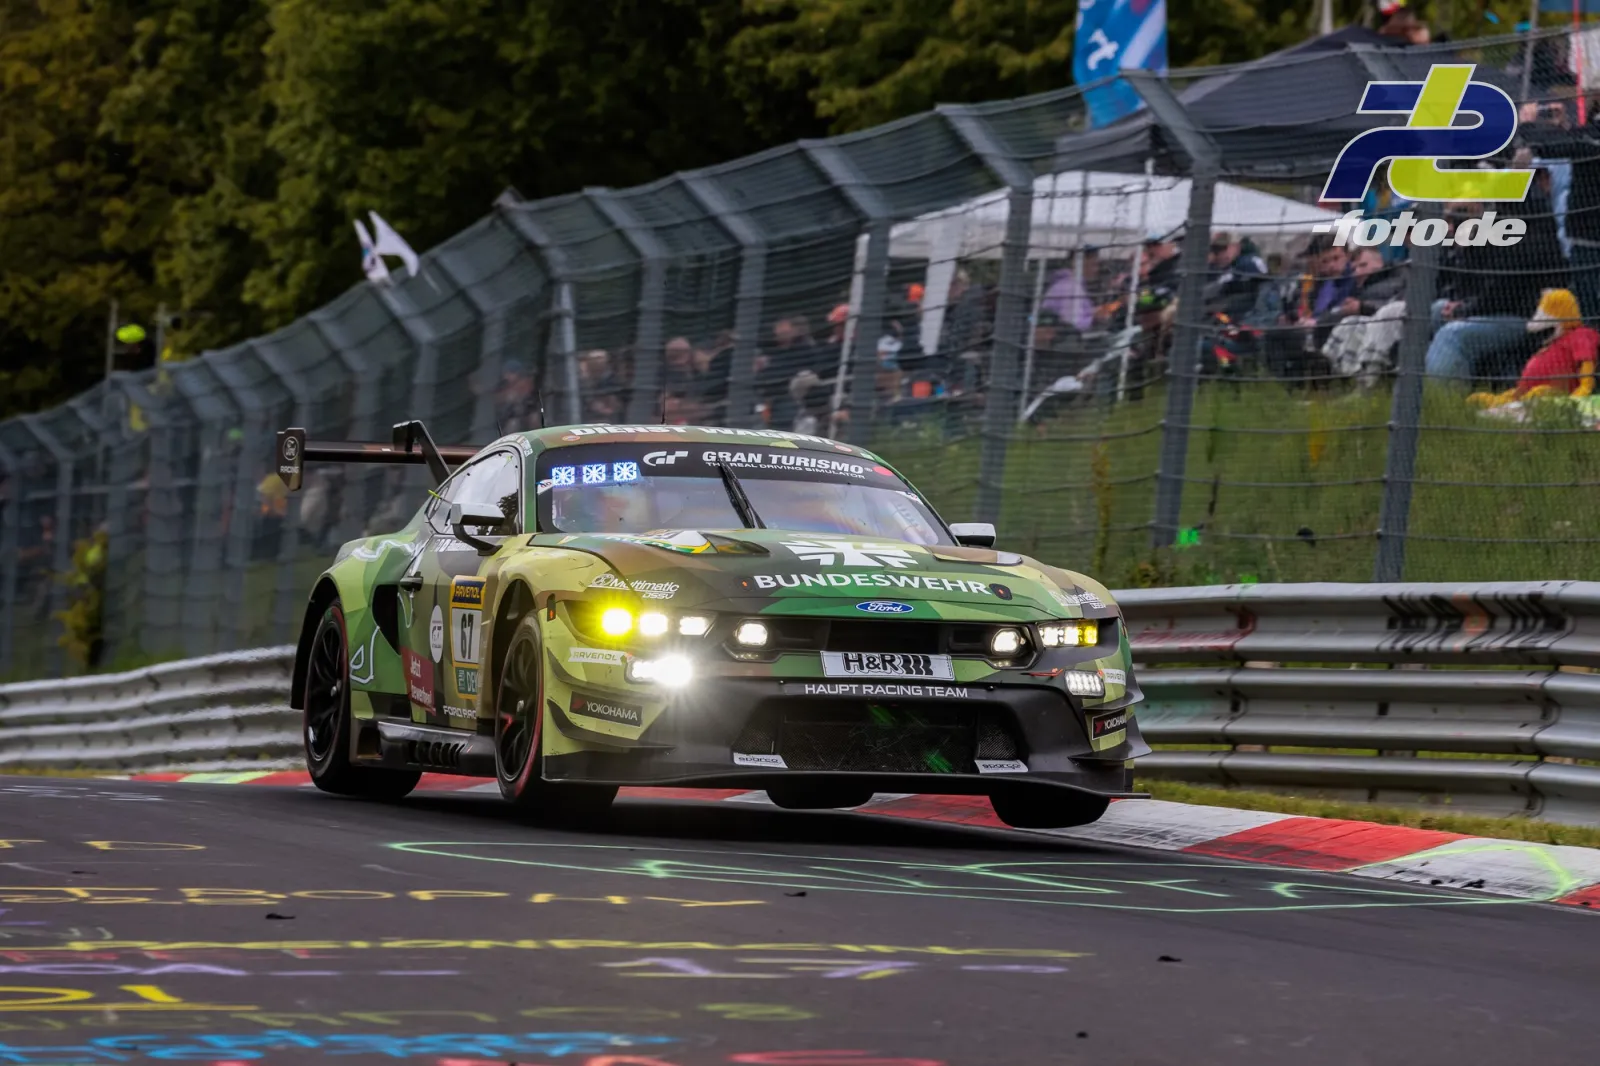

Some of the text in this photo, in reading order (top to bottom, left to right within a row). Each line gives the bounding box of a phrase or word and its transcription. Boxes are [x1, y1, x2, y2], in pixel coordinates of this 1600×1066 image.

[569, 426, 688, 436] DIENST
[702, 451, 762, 464] GRAN
[760, 465, 801, 473] DRIVING
[805, 467, 866, 480] SIMULATOR
[754, 573, 992, 596] BUNDESWEHR
[455, 585, 481, 600] RAVENOL
[867, 602, 903, 613] Ford
[461, 613, 475, 661] 67
[573, 651, 618, 661] RAVENOL
[842, 652, 904, 674] H&R
[804, 684, 968, 698] HAUPT RACING TEAM
[587, 701, 638, 721] YOKOHAMA
